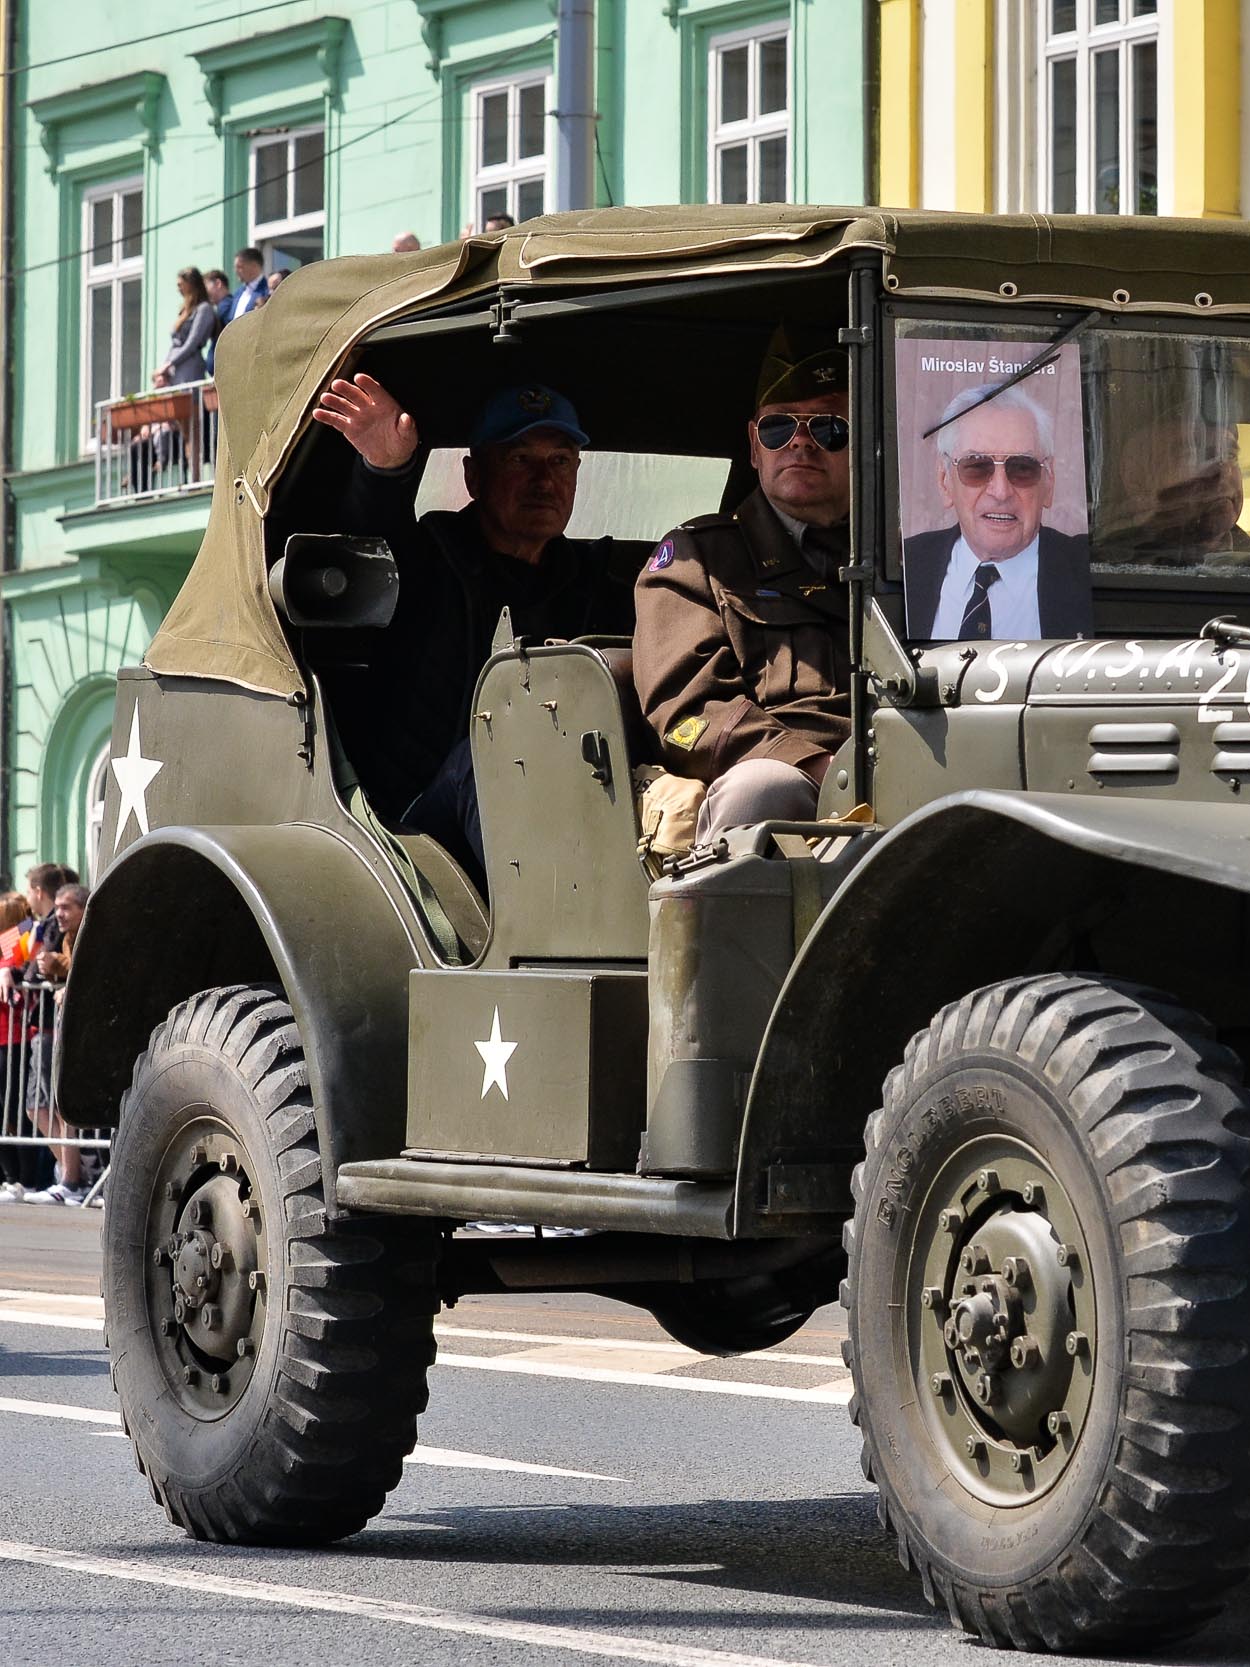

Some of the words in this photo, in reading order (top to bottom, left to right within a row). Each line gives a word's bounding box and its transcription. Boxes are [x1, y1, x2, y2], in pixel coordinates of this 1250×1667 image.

[921, 357, 985, 372] Miroslav
[975, 642, 1028, 702] S
[1052, 640, 1204, 678] U.S.A.
